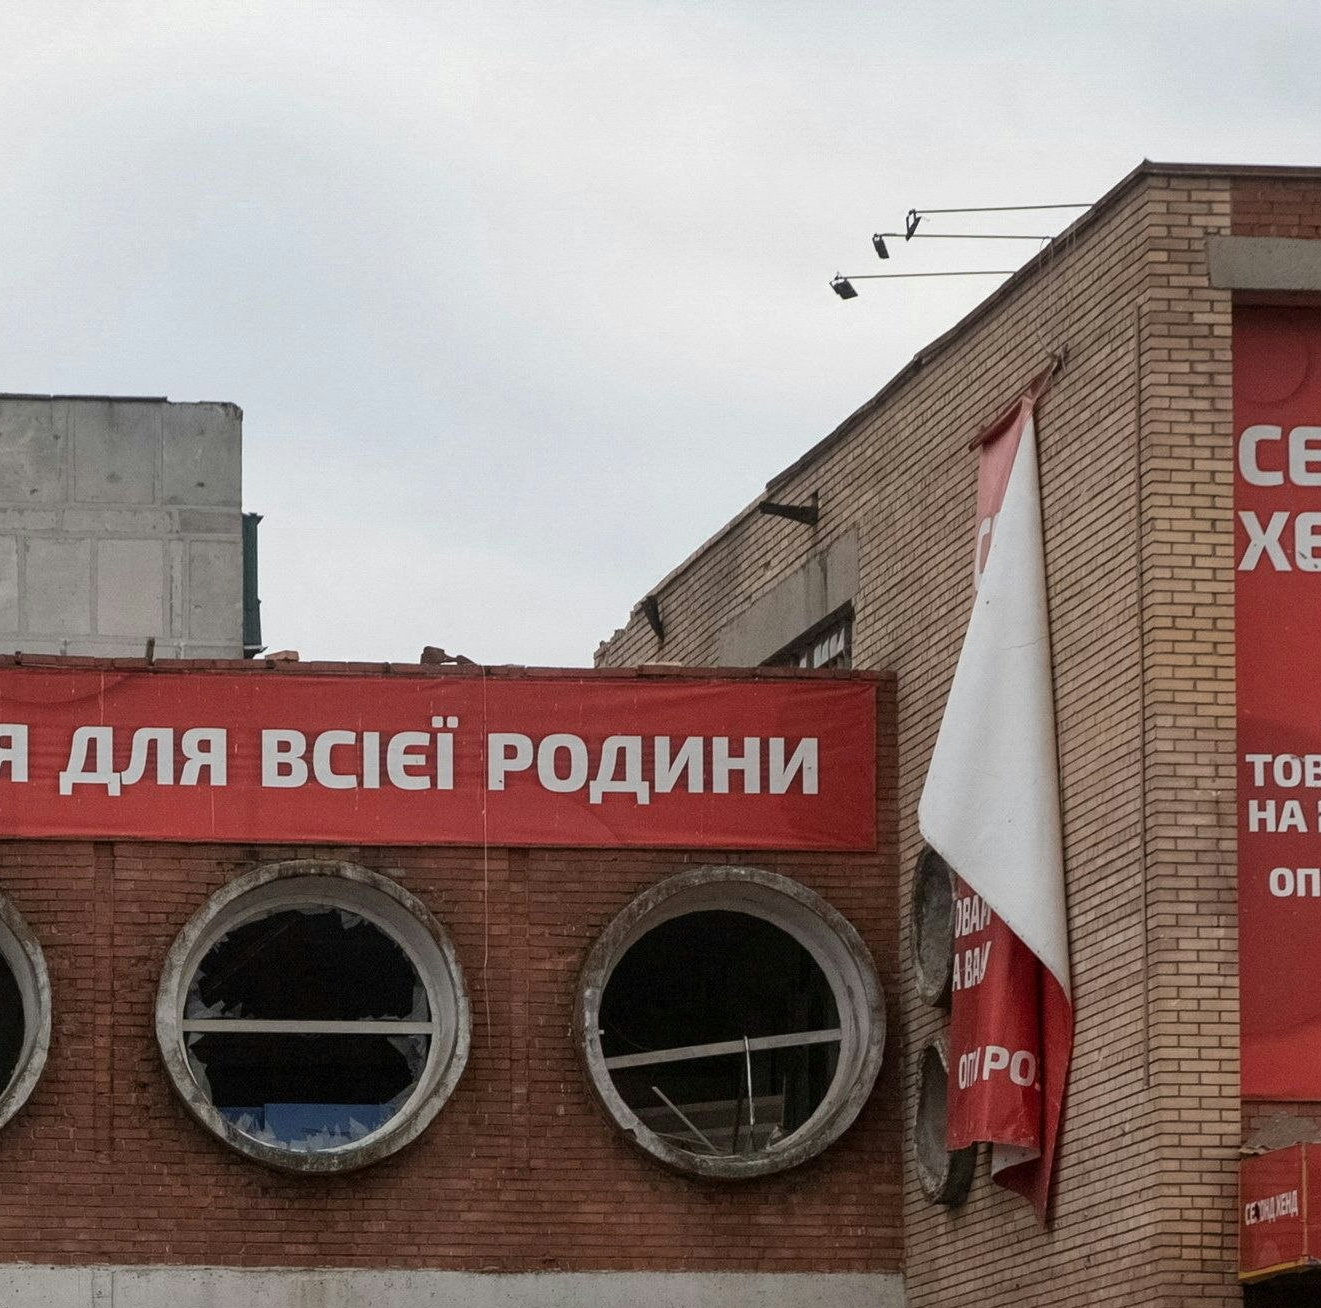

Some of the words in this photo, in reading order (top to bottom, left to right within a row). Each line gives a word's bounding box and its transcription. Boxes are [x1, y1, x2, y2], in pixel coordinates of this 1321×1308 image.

[59, 726, 227, 796] ДЛЯ
[262, 716, 458, 790] ВСІЄЇ
[488, 733, 818, 804] РОДИНИ
[1249, 800, 1308, 832] НА
